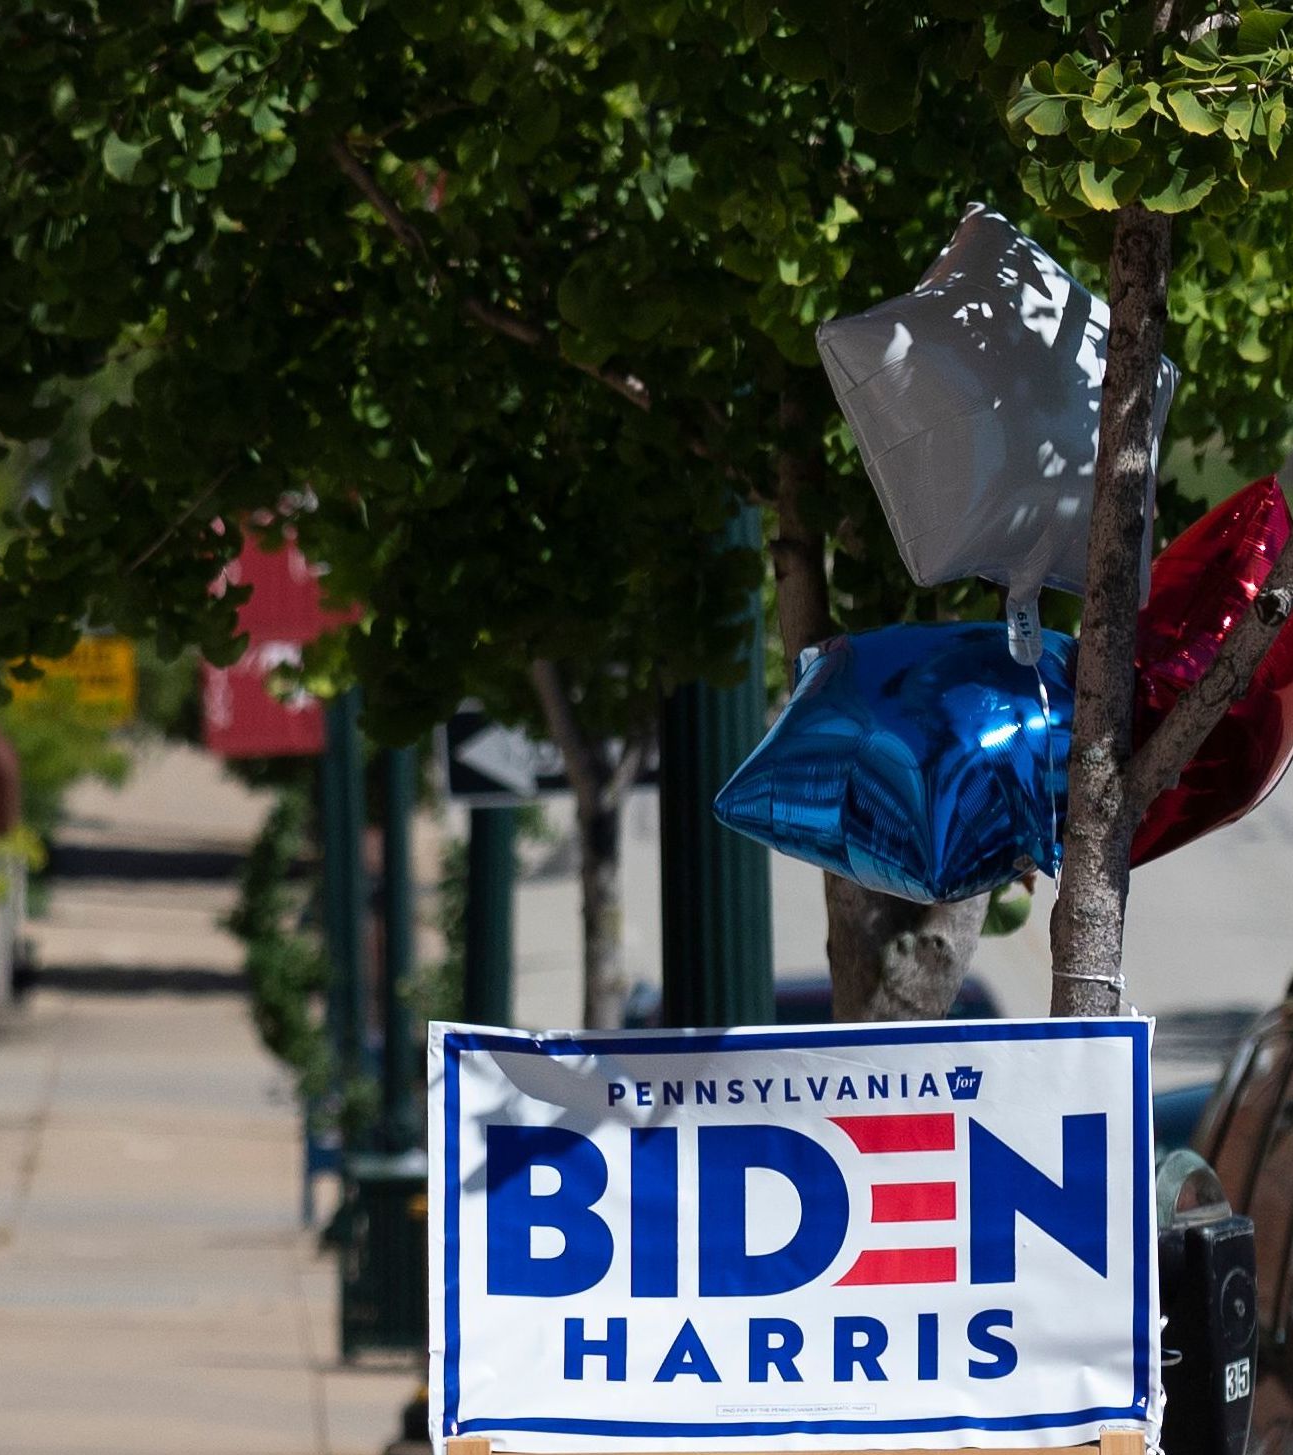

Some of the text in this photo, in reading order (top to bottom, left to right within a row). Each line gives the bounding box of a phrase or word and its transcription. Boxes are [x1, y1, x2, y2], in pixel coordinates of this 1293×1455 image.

[608, 1072, 978, 1107] PENNSYLVANIA for
[486, 1111, 1108, 1299] BIDEN
[563, 1308, 1019, 1384] HARRIS
[1227, 1361, 1250, 1399] 35
